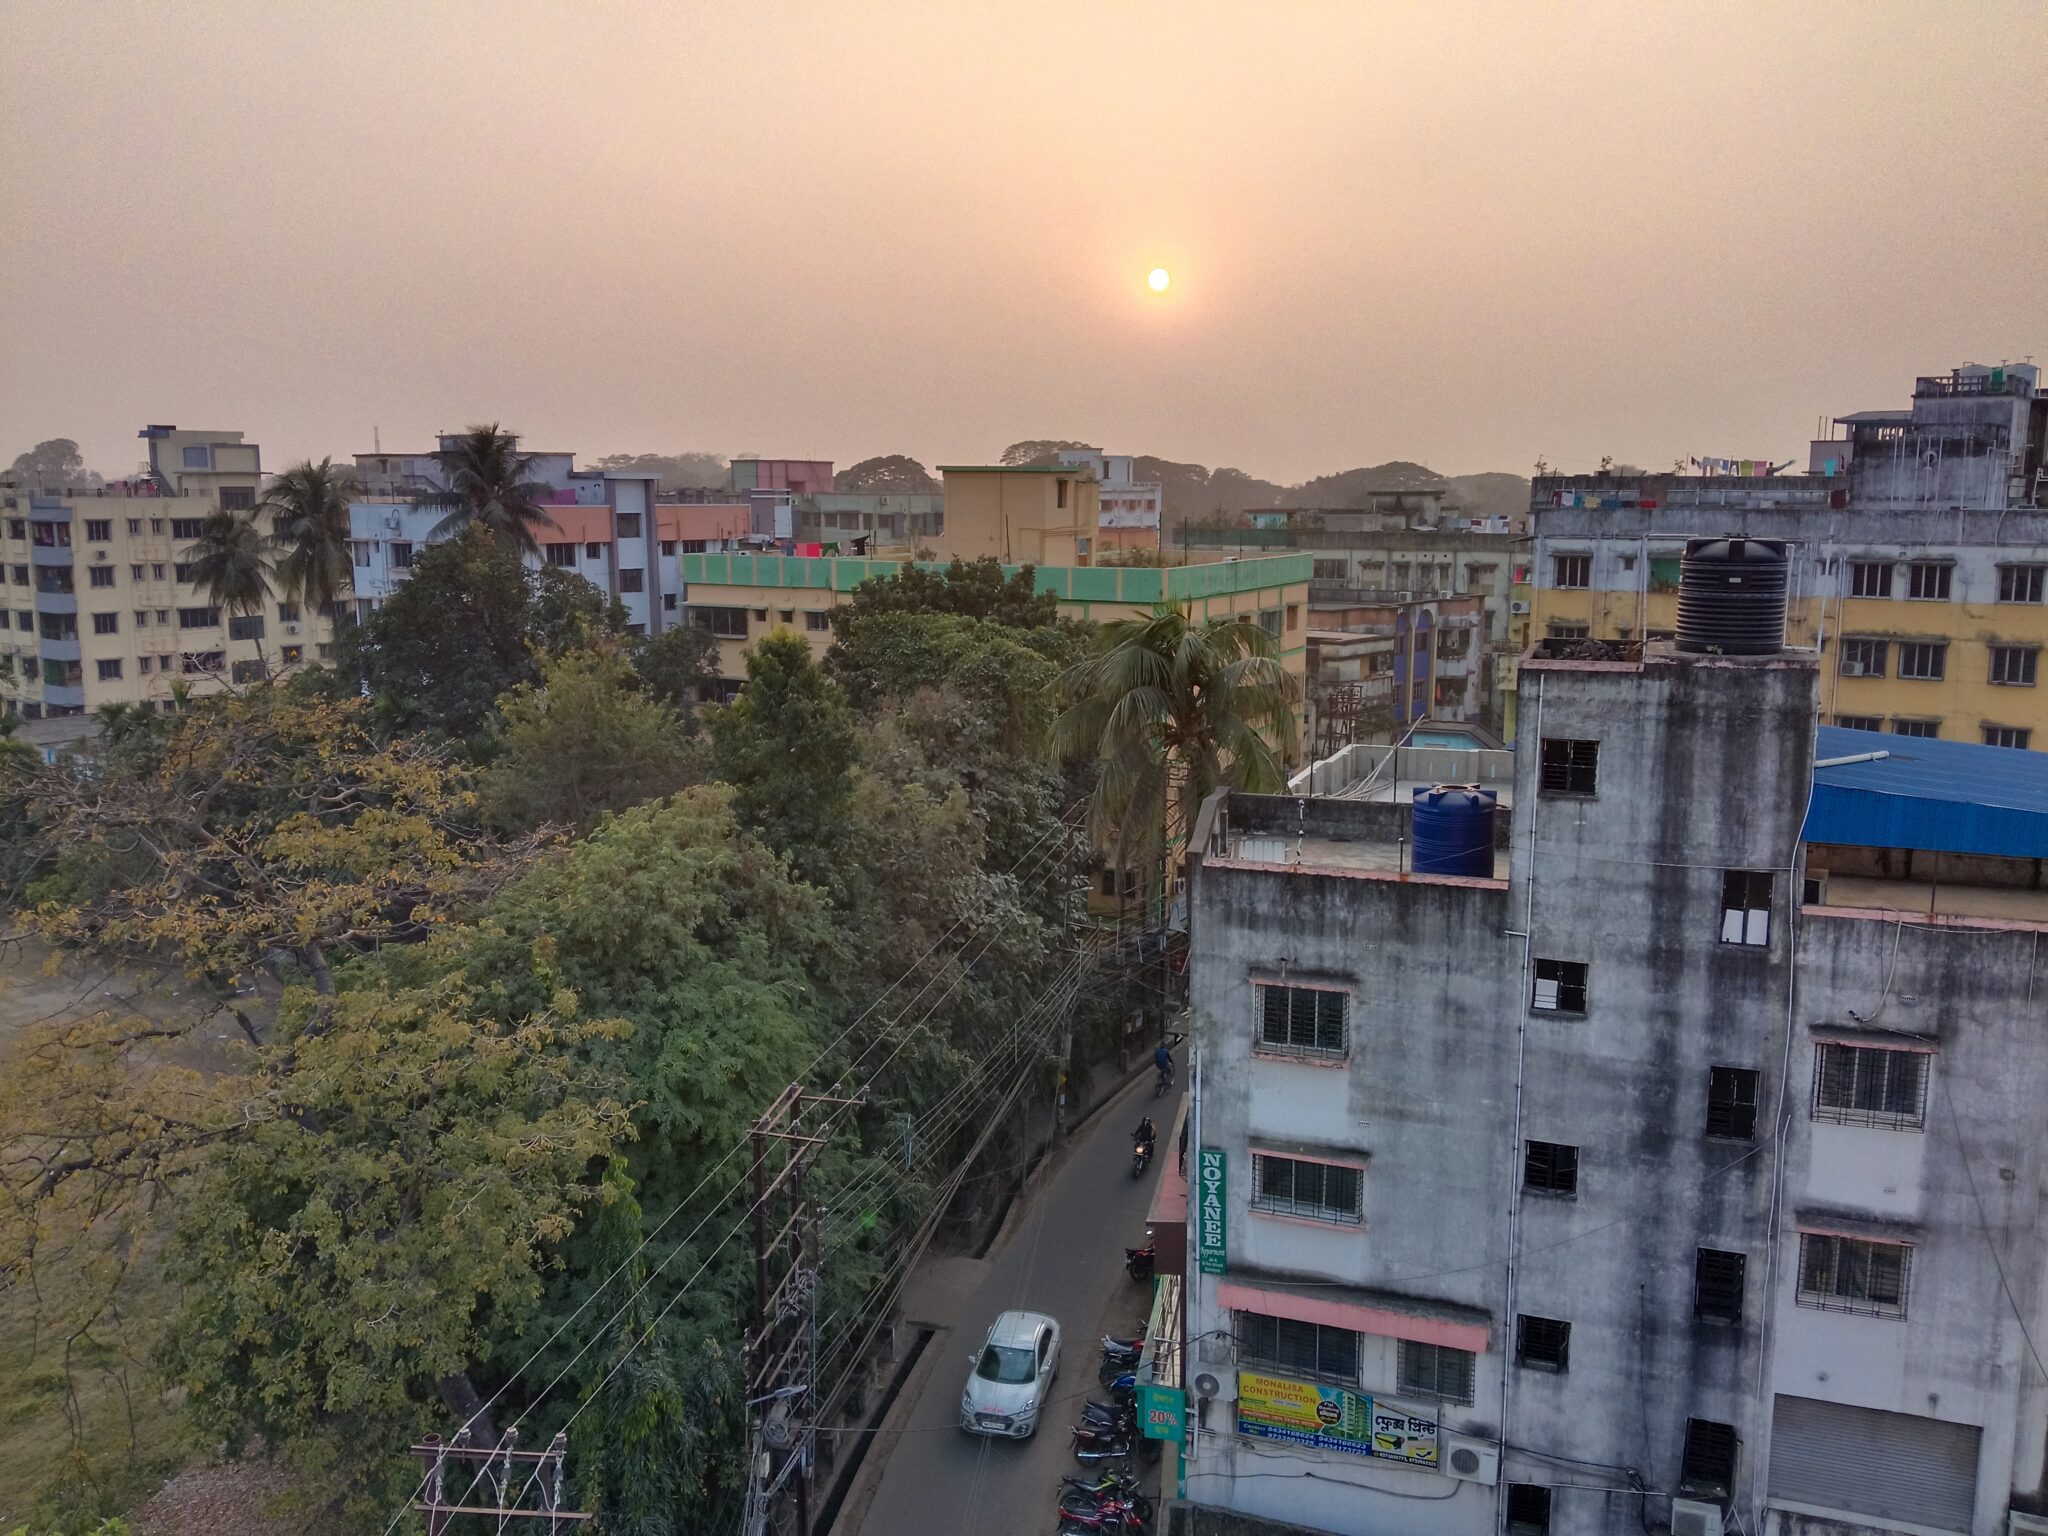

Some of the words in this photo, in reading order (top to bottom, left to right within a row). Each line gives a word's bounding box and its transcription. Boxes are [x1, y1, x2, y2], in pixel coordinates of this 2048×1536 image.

[1203, 1153, 1221, 1247] NOYANEE
[1256, 1378, 1303, 1393] MONALISA
[1244, 1385, 1316, 1404] CONSTRUCTION
[1149, 1409, 1178, 1426] 20%
[1287, 1423, 1315, 1432] FACILITY
